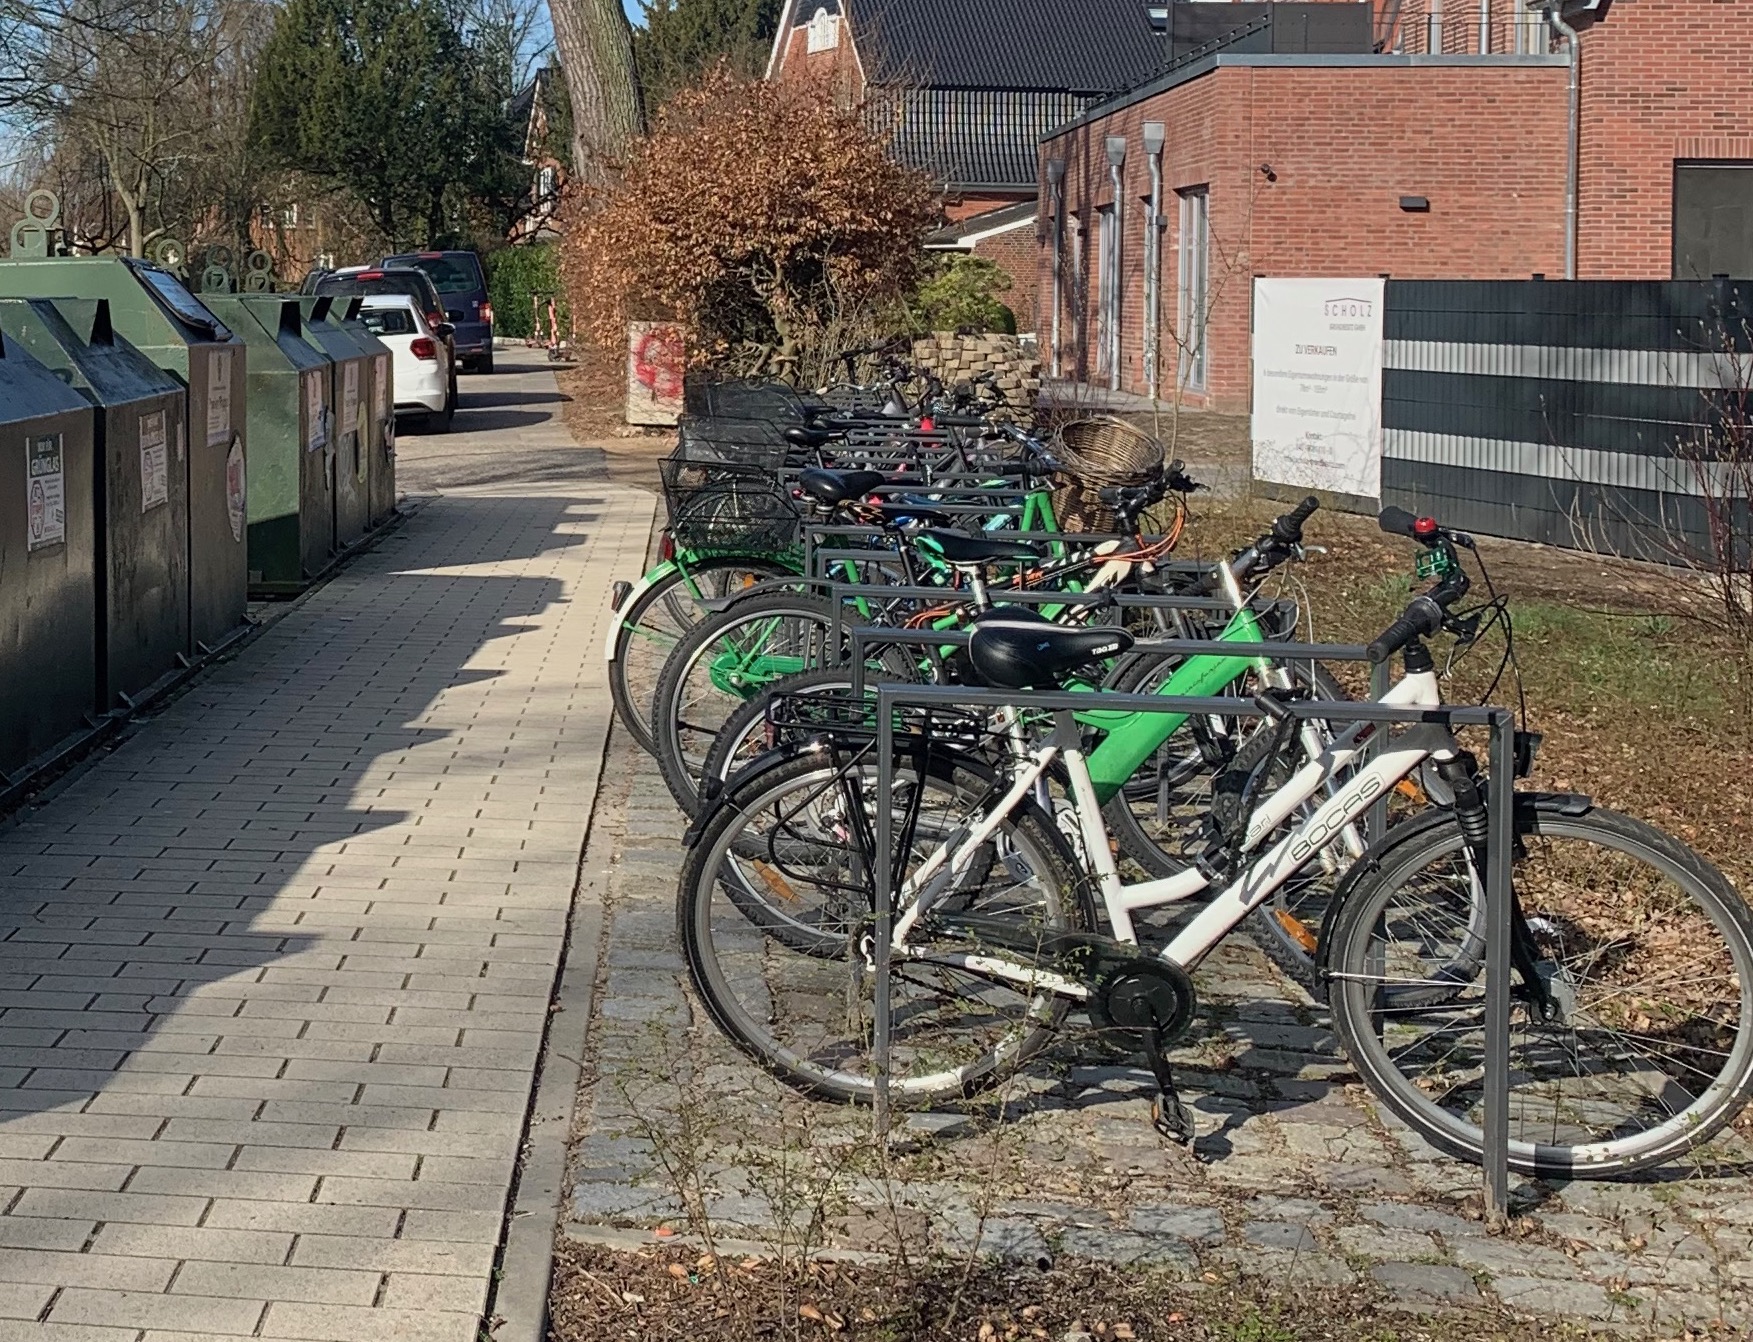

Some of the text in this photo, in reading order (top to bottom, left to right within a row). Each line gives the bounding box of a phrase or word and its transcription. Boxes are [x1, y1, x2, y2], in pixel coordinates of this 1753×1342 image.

[1324, 304, 1372, 317] SCHOLZ
[1295, 344, 1338, 356] ZU VERKAUFEN
[1291, 776, 1382, 862] BOCAS
